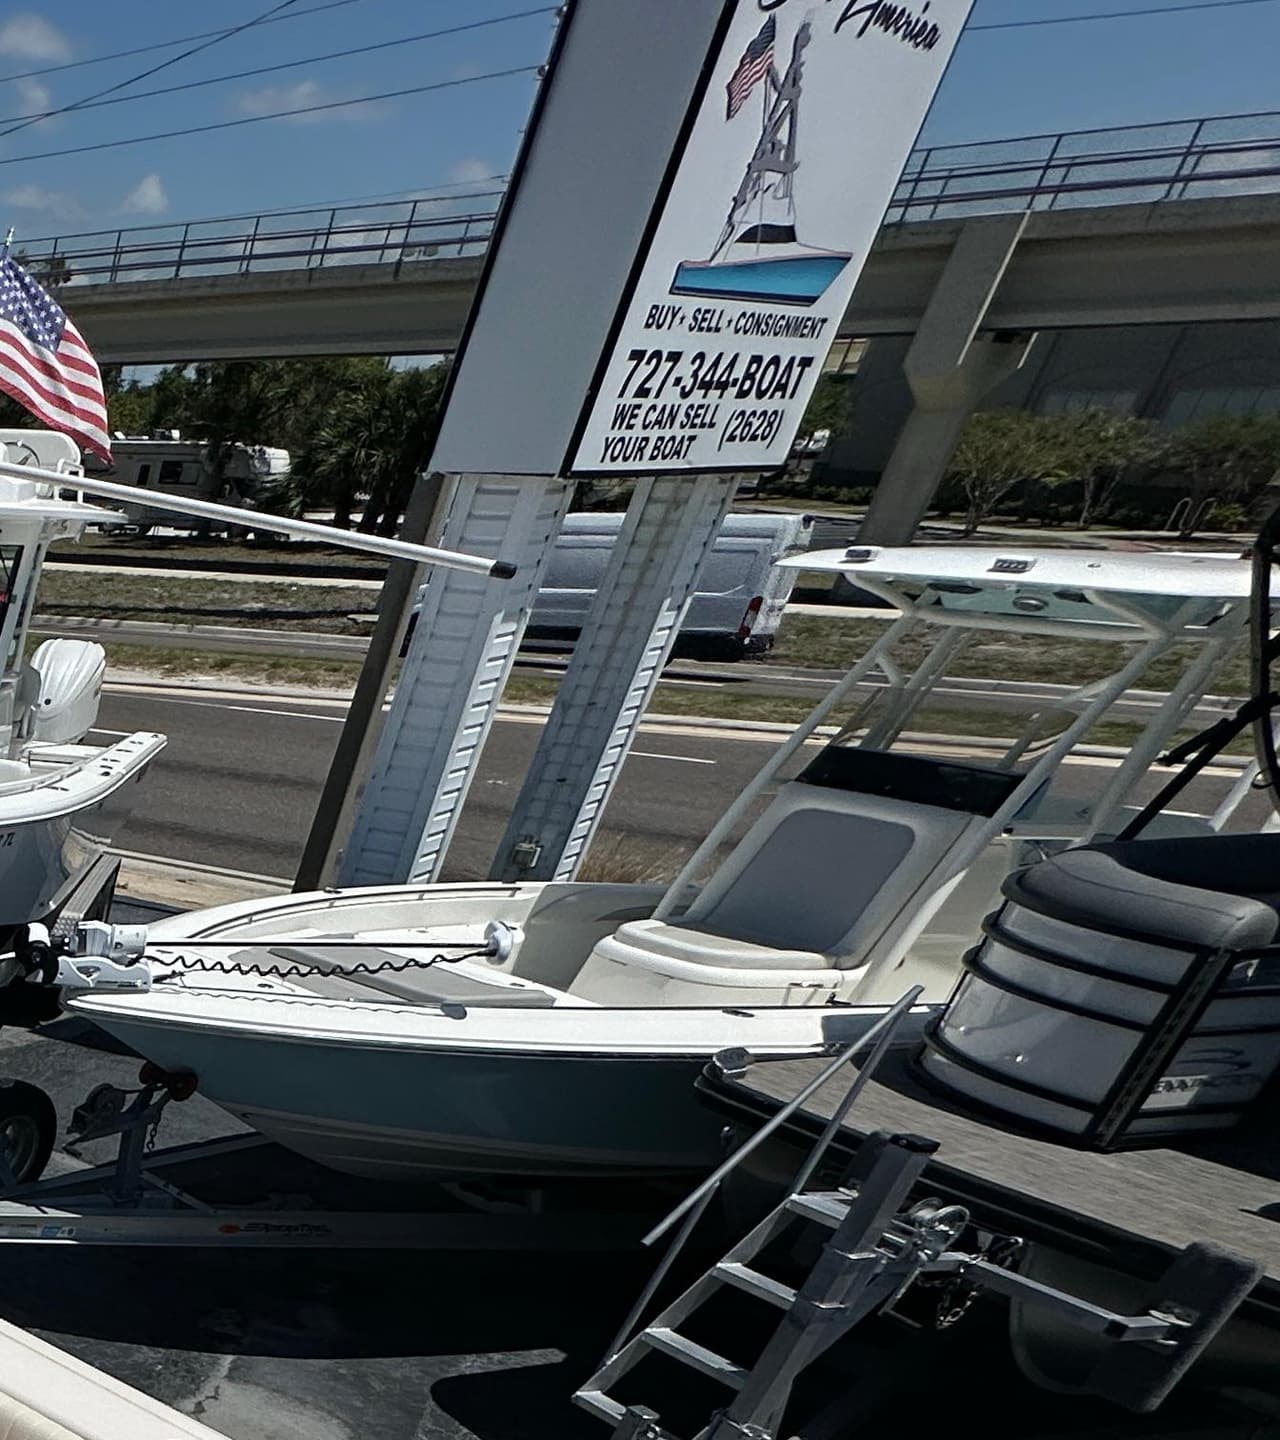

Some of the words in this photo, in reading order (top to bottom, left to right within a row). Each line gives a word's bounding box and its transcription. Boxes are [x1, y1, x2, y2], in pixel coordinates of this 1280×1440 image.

[644, 304, 681, 330] BUY
[688, 307, 724, 333] SELL
[733, 311, 829, 339] CONSIGNMENT
[617, 349, 815, 400] 727-344-BOAT
[610, 403, 642, 431] WE
[642, 403, 681, 431] CAN
[679, 403, 720, 430] SELL
[717, 409, 785, 452] (2628)
[600, 436, 650, 464] YOUR
[648, 435, 698, 461] BOAT
